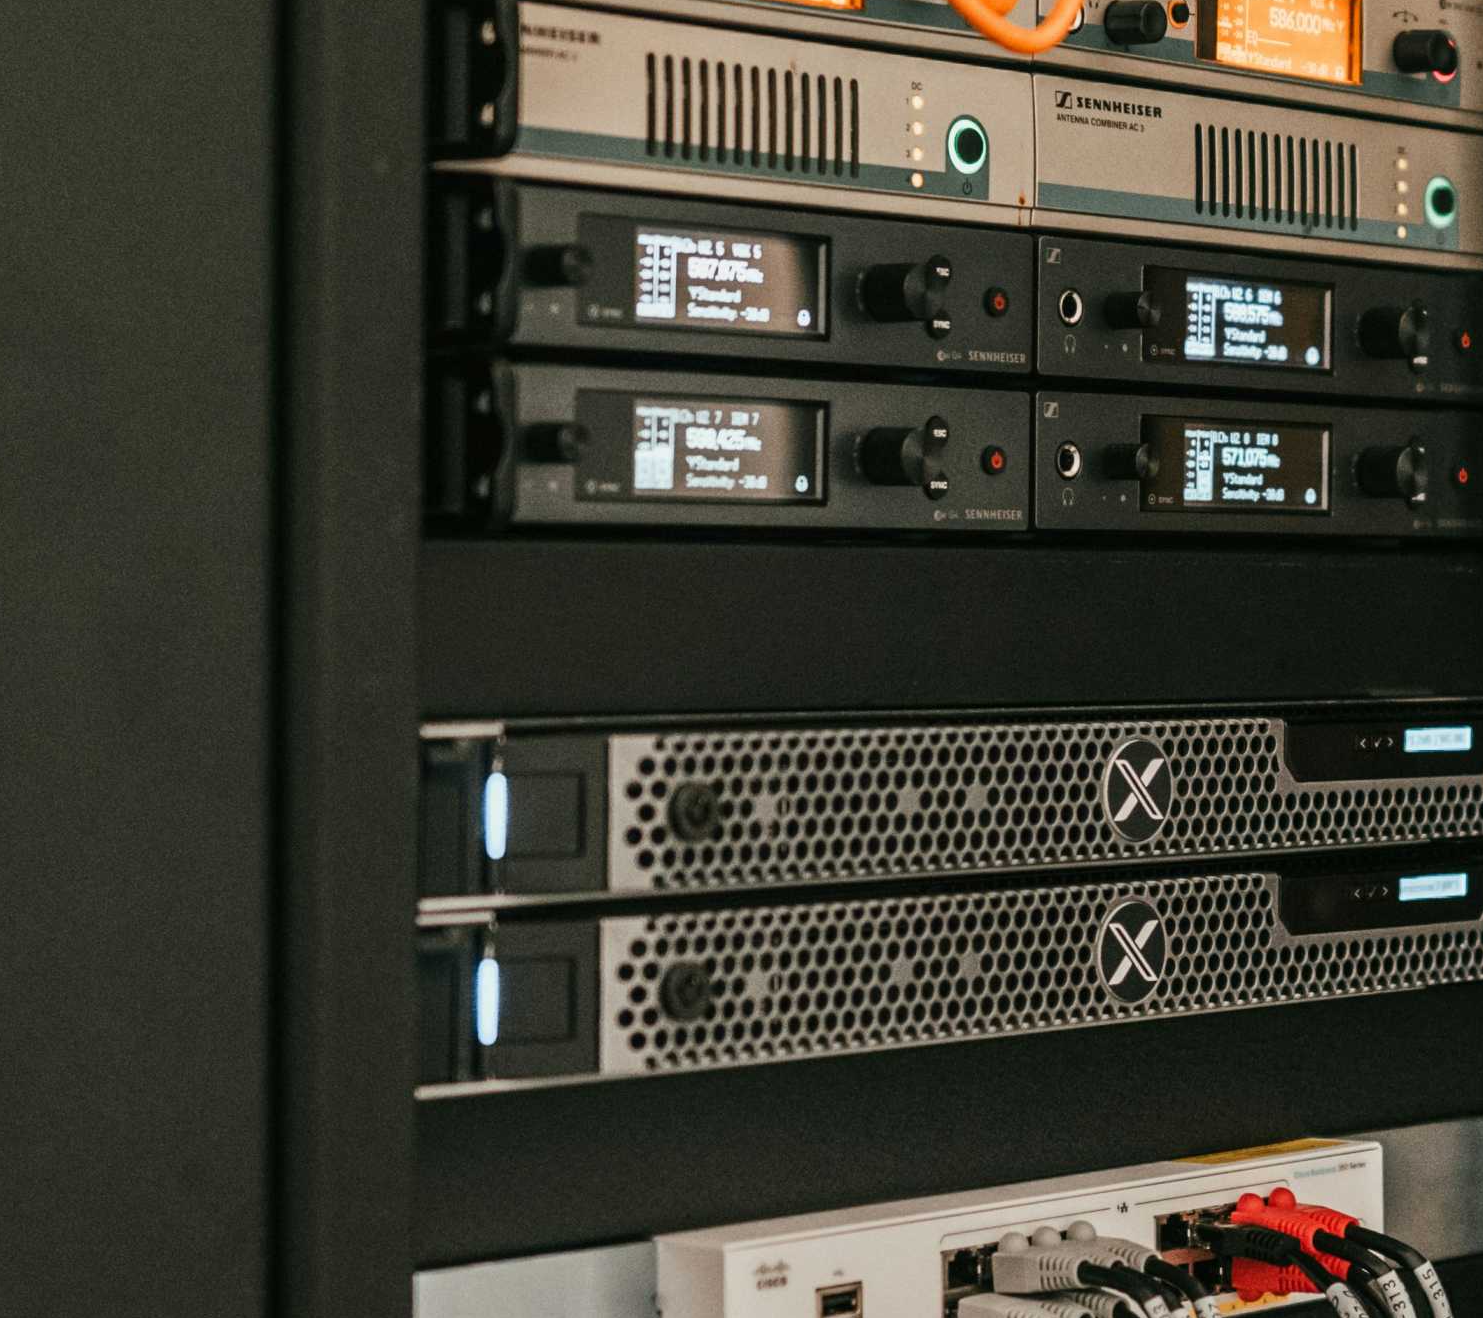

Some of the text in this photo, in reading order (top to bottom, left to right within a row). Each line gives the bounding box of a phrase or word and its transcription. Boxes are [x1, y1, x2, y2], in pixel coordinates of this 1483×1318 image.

[1269, 7, 1322, 35] 586.000
[1076, 96, 1162, 119] SENNHEISER
[1057, 112, 1090, 126] ANTENNA
[1091, 117, 1128, 130] COMBINER
[1129, 122, 1139, 132] AC
[968, 350, 1026, 364] SENNHEISER
[964, 509, 1023, 521] SENNHEISER
